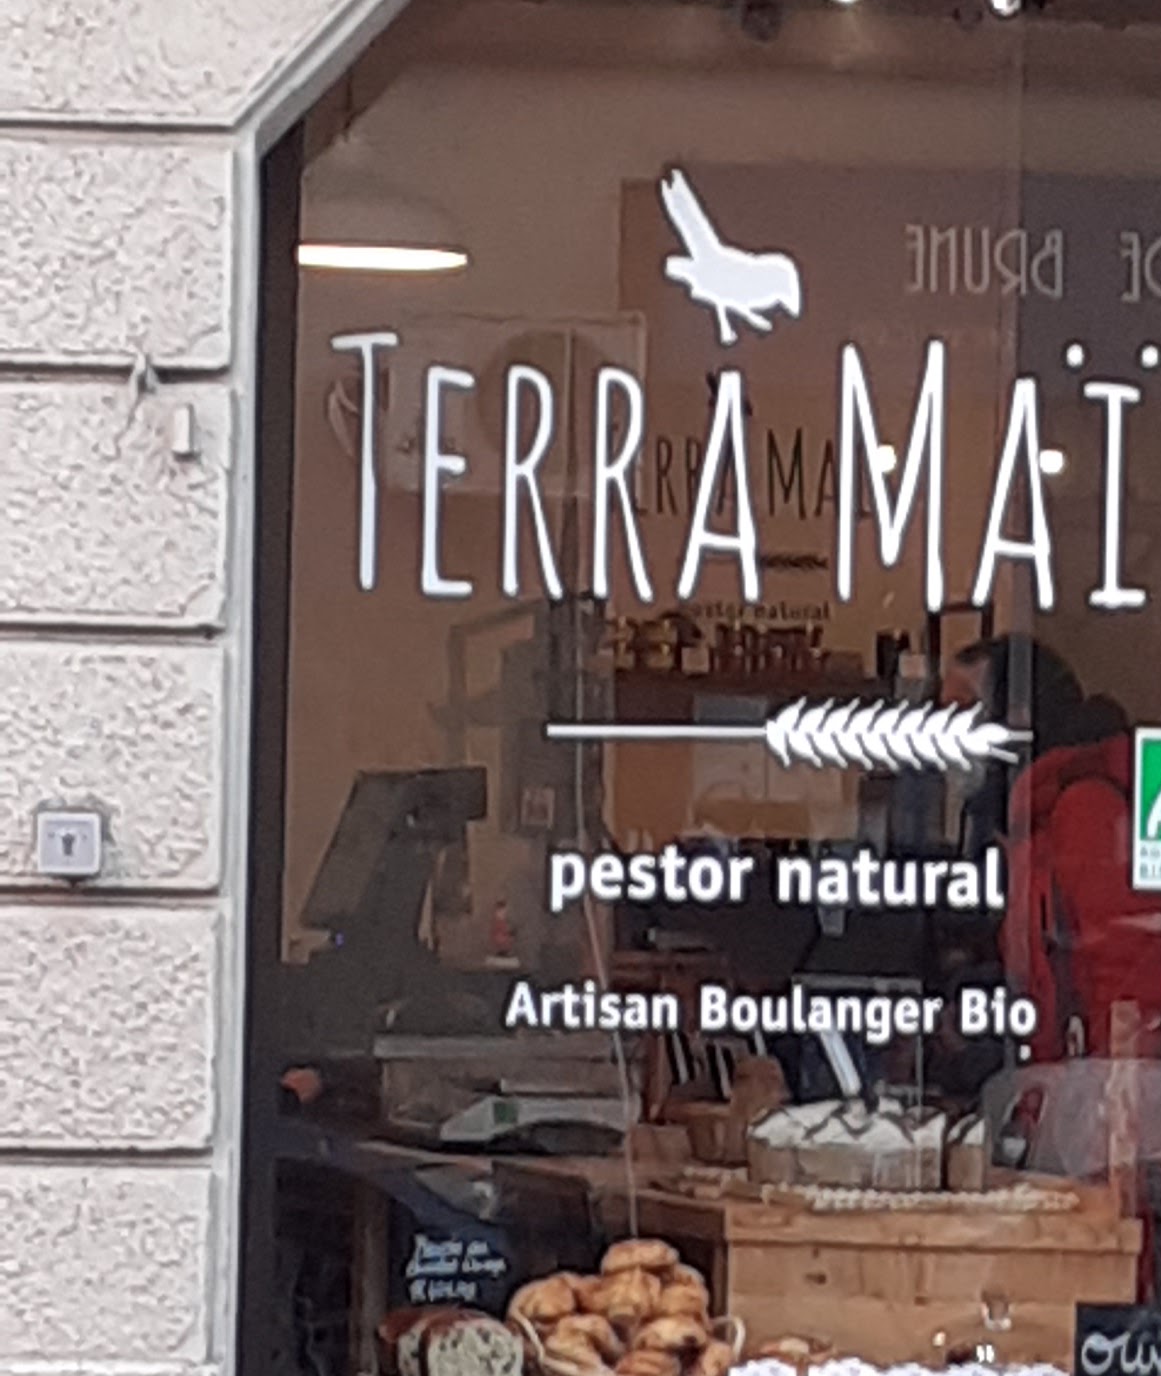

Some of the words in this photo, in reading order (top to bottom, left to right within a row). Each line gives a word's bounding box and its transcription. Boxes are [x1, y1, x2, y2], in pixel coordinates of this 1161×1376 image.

[331, 332, 763, 601] TERRA
[550, 844, 754, 913] pestor
[777, 847, 1005, 909] natural
[505, 981, 678, 1028] Artisan
[700, 984, 942, 1043] Boulanger
[960, 987, 1037, 1035] Bio
